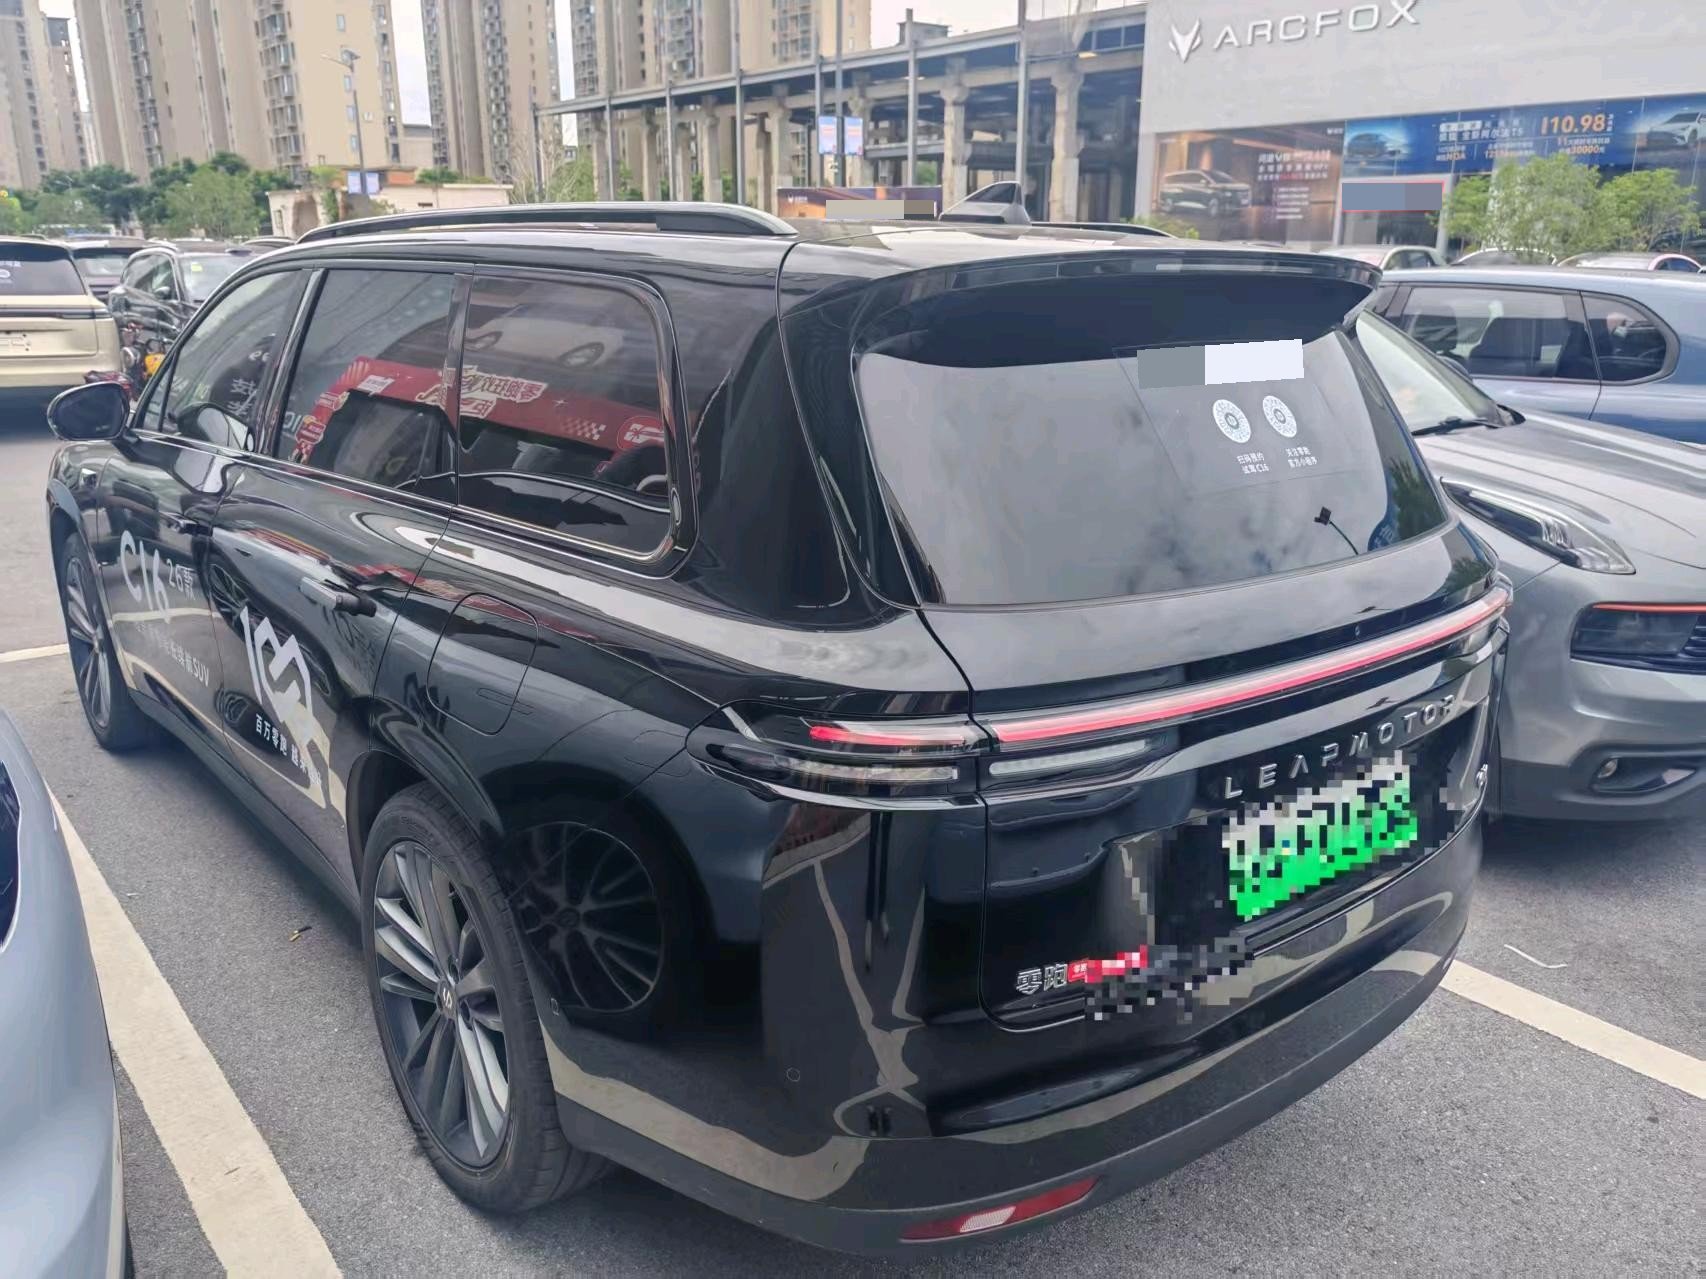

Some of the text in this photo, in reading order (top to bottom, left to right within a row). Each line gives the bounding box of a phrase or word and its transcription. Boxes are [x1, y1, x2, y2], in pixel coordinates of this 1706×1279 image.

[1214, 0, 1420, 49] ARCFOX
[120, 529, 170, 624] C16
[256, 713, 288, 756] 百万零跑
[1224, 693, 1457, 799] LEAPMOTOR
[1016, 963, 1068, 995] 零跑
